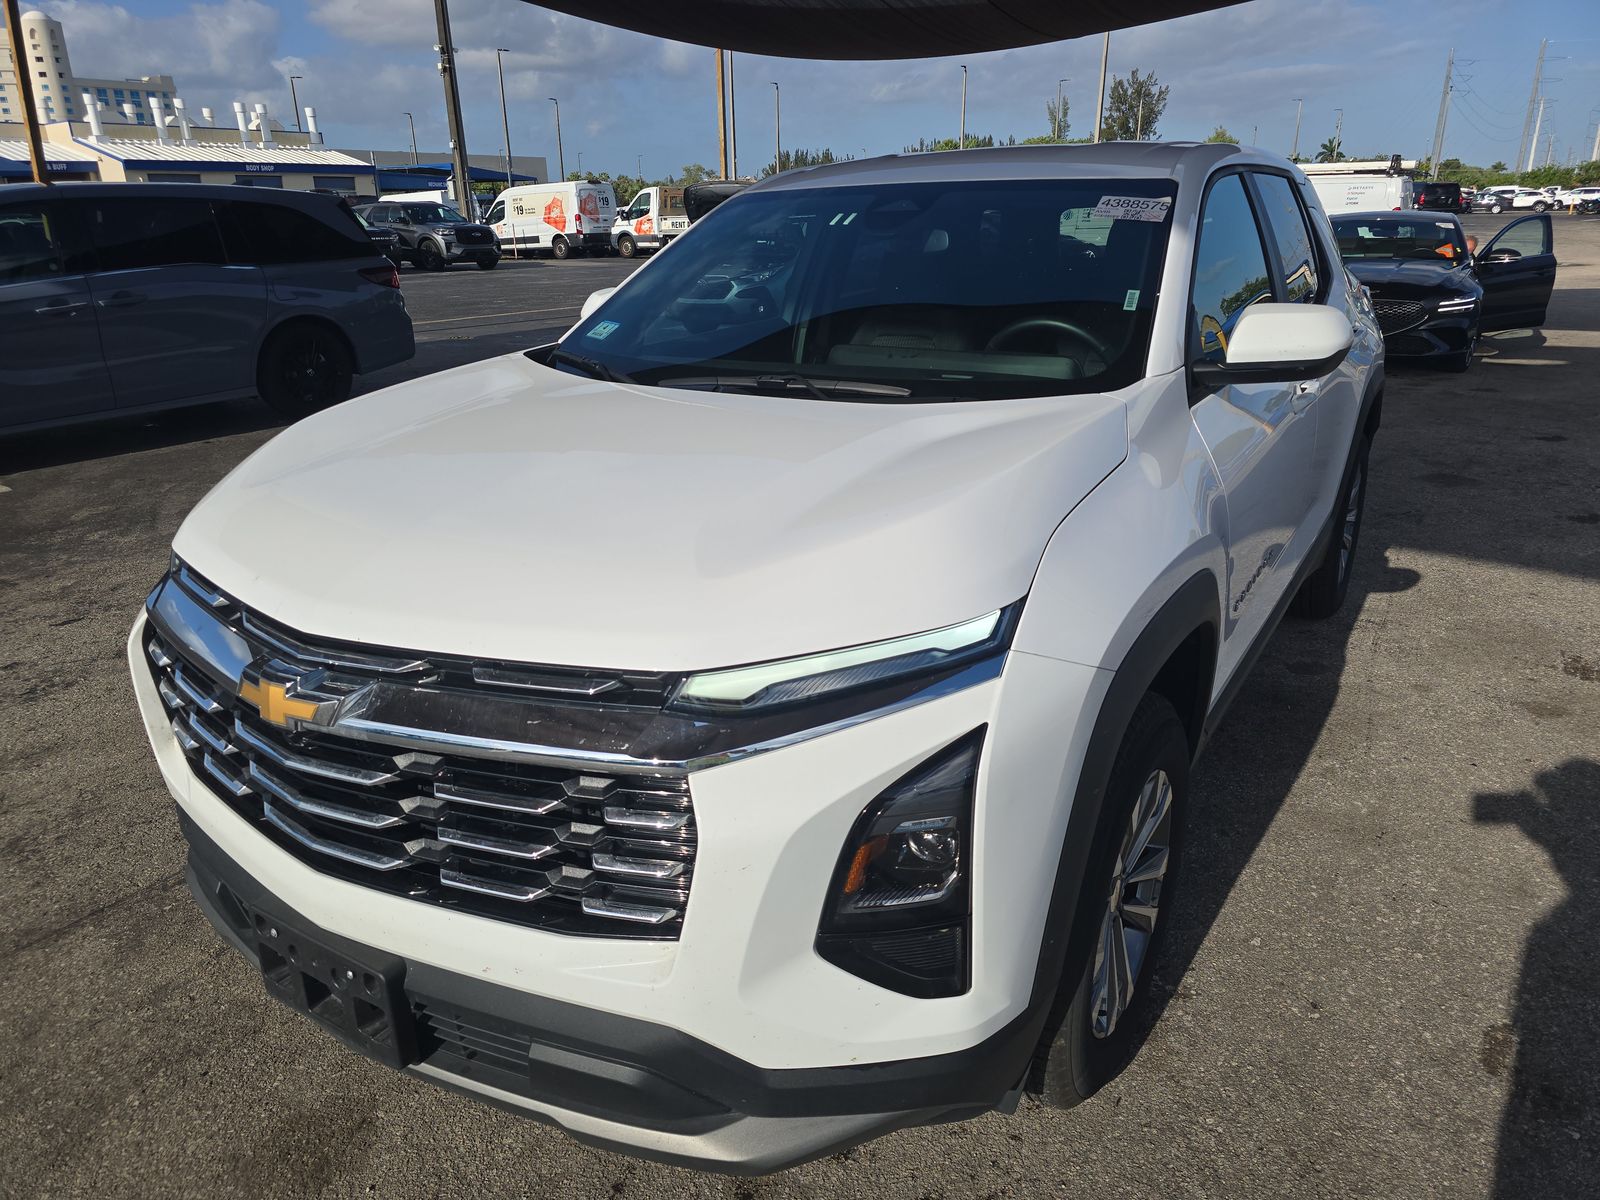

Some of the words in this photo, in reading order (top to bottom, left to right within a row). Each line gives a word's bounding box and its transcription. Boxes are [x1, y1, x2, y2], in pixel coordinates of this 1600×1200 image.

[598, 196, 609, 206] $19
[1101, 198, 1171, 211] 4388575
[513, 205, 524, 215] $19
[671, 221, 686, 229] RENT
